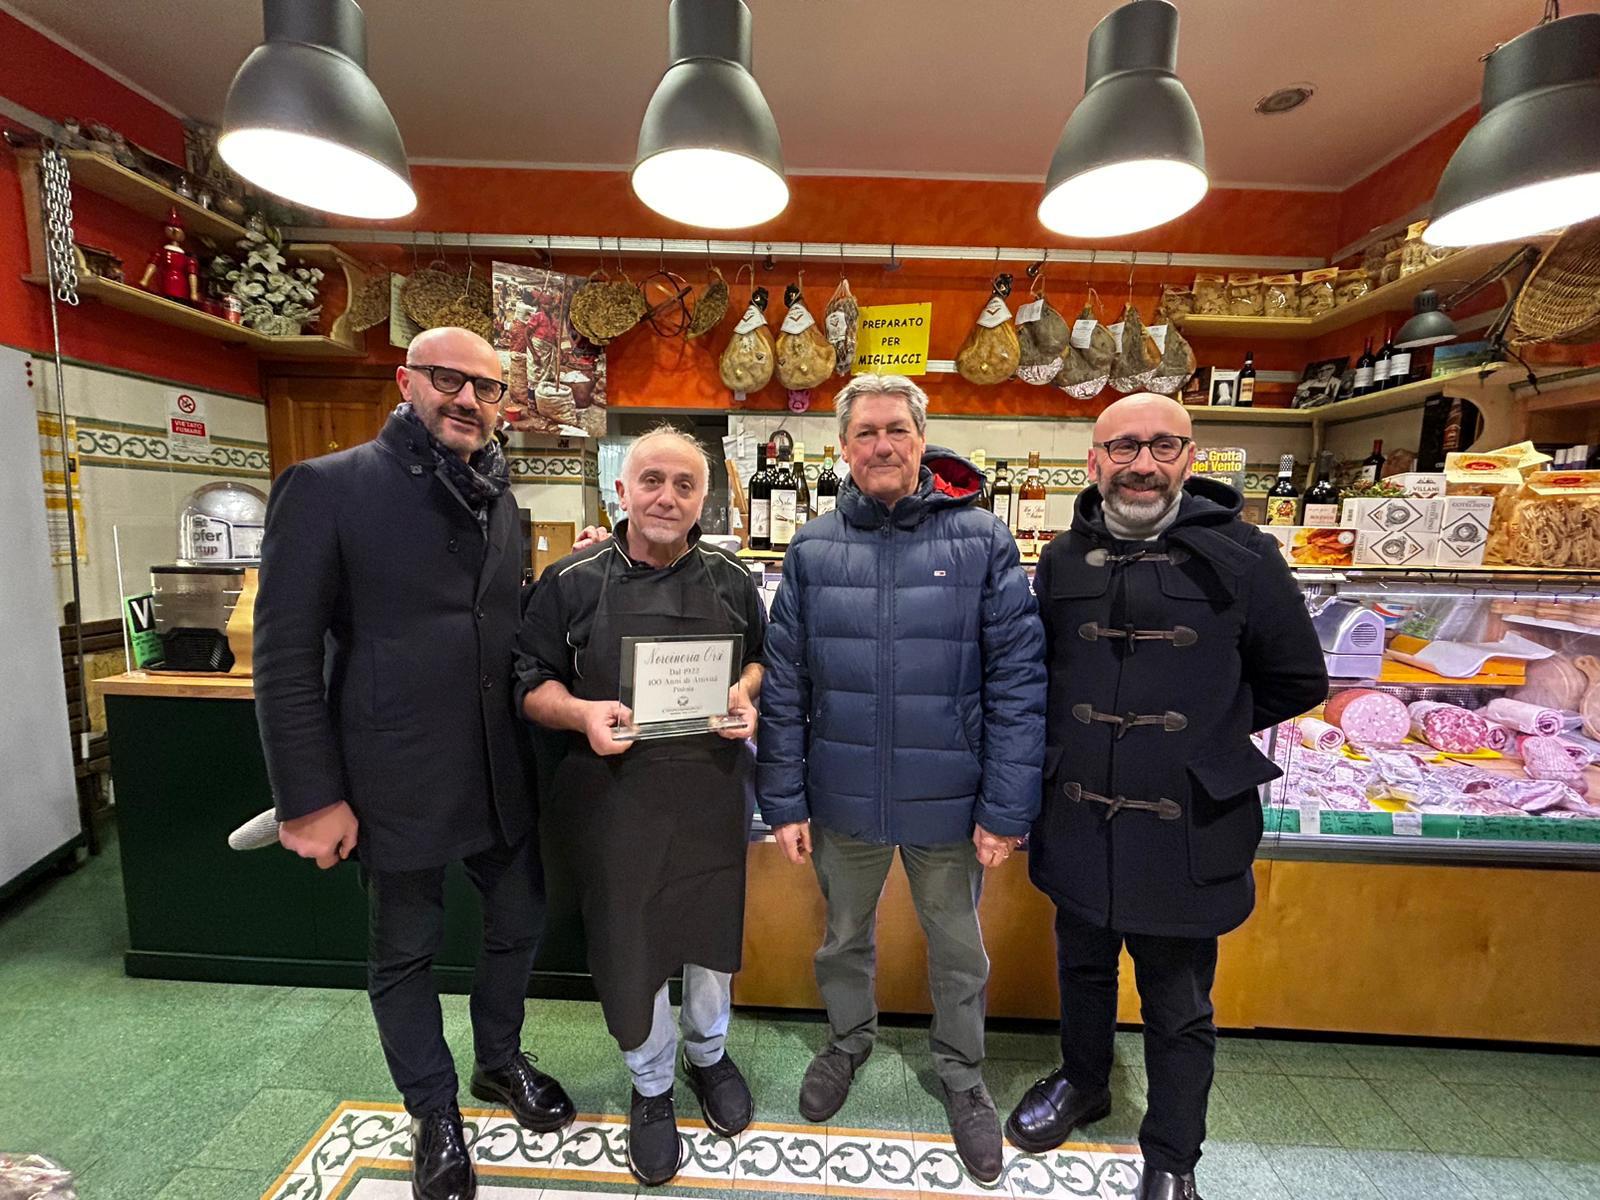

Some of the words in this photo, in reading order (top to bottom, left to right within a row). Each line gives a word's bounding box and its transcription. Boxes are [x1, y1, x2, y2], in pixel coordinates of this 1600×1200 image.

[862, 317, 923, 328] PREPARATO
[881, 337, 900, 346] PER
[859, 353, 921, 365] MIGLIACCI
[174, 420, 203, 429] VIETATO
[1209, 451, 1242, 461] Grotta
[1191, 461, 1209, 472] del
[1211, 460, 1242, 472] Vento
[669, 668, 682, 677] Dal
